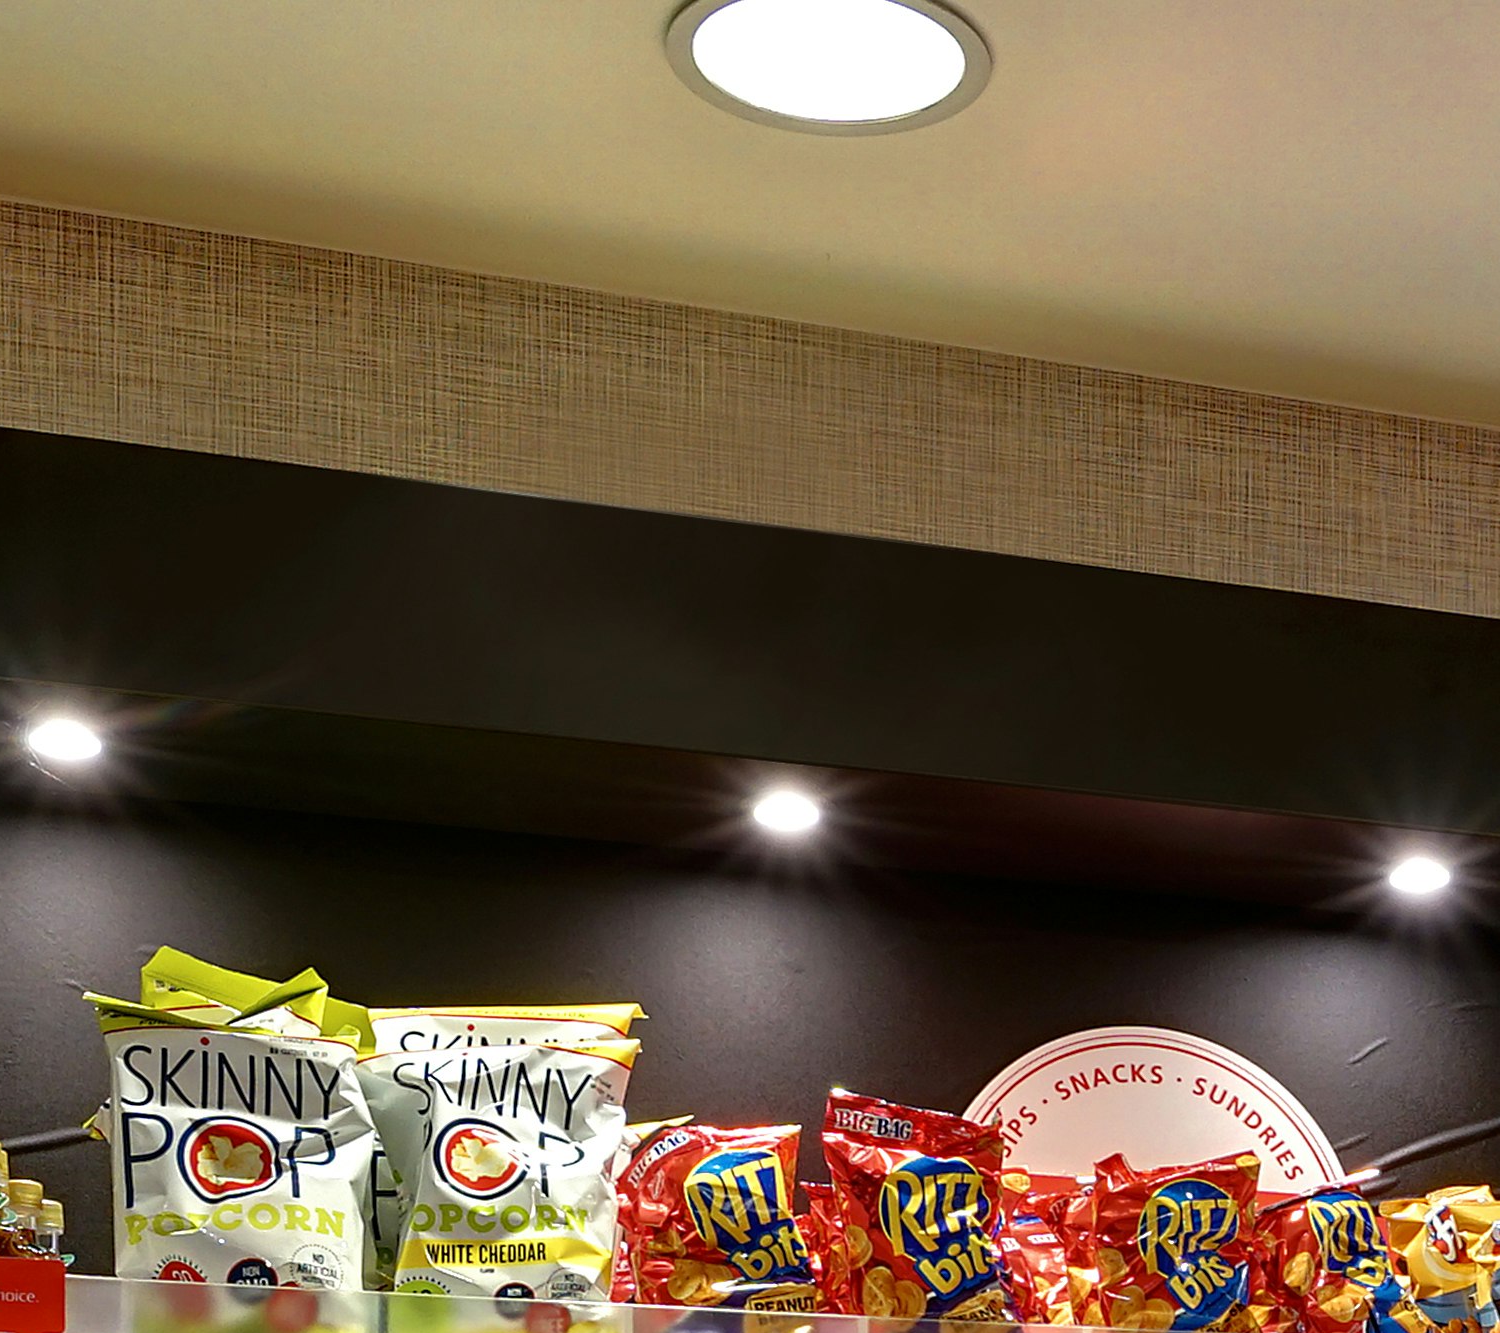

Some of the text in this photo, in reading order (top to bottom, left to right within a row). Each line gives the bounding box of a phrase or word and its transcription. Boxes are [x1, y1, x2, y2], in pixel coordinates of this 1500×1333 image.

[121, 1036, 341, 1121] SKINNY
[121, 1112, 336, 1209] POP
[833, 1108, 913, 1141] BIG BAG
[1054, 1063, 1305, 1181] SNACKS SUNDRIES
[684, 1156, 792, 1252] RITZ
[880, 1171, 984, 1257] RITZ
[1140, 1196, 1239, 1277] RITZ
[427, 1241, 547, 1264] WHITE CHEDDAR
